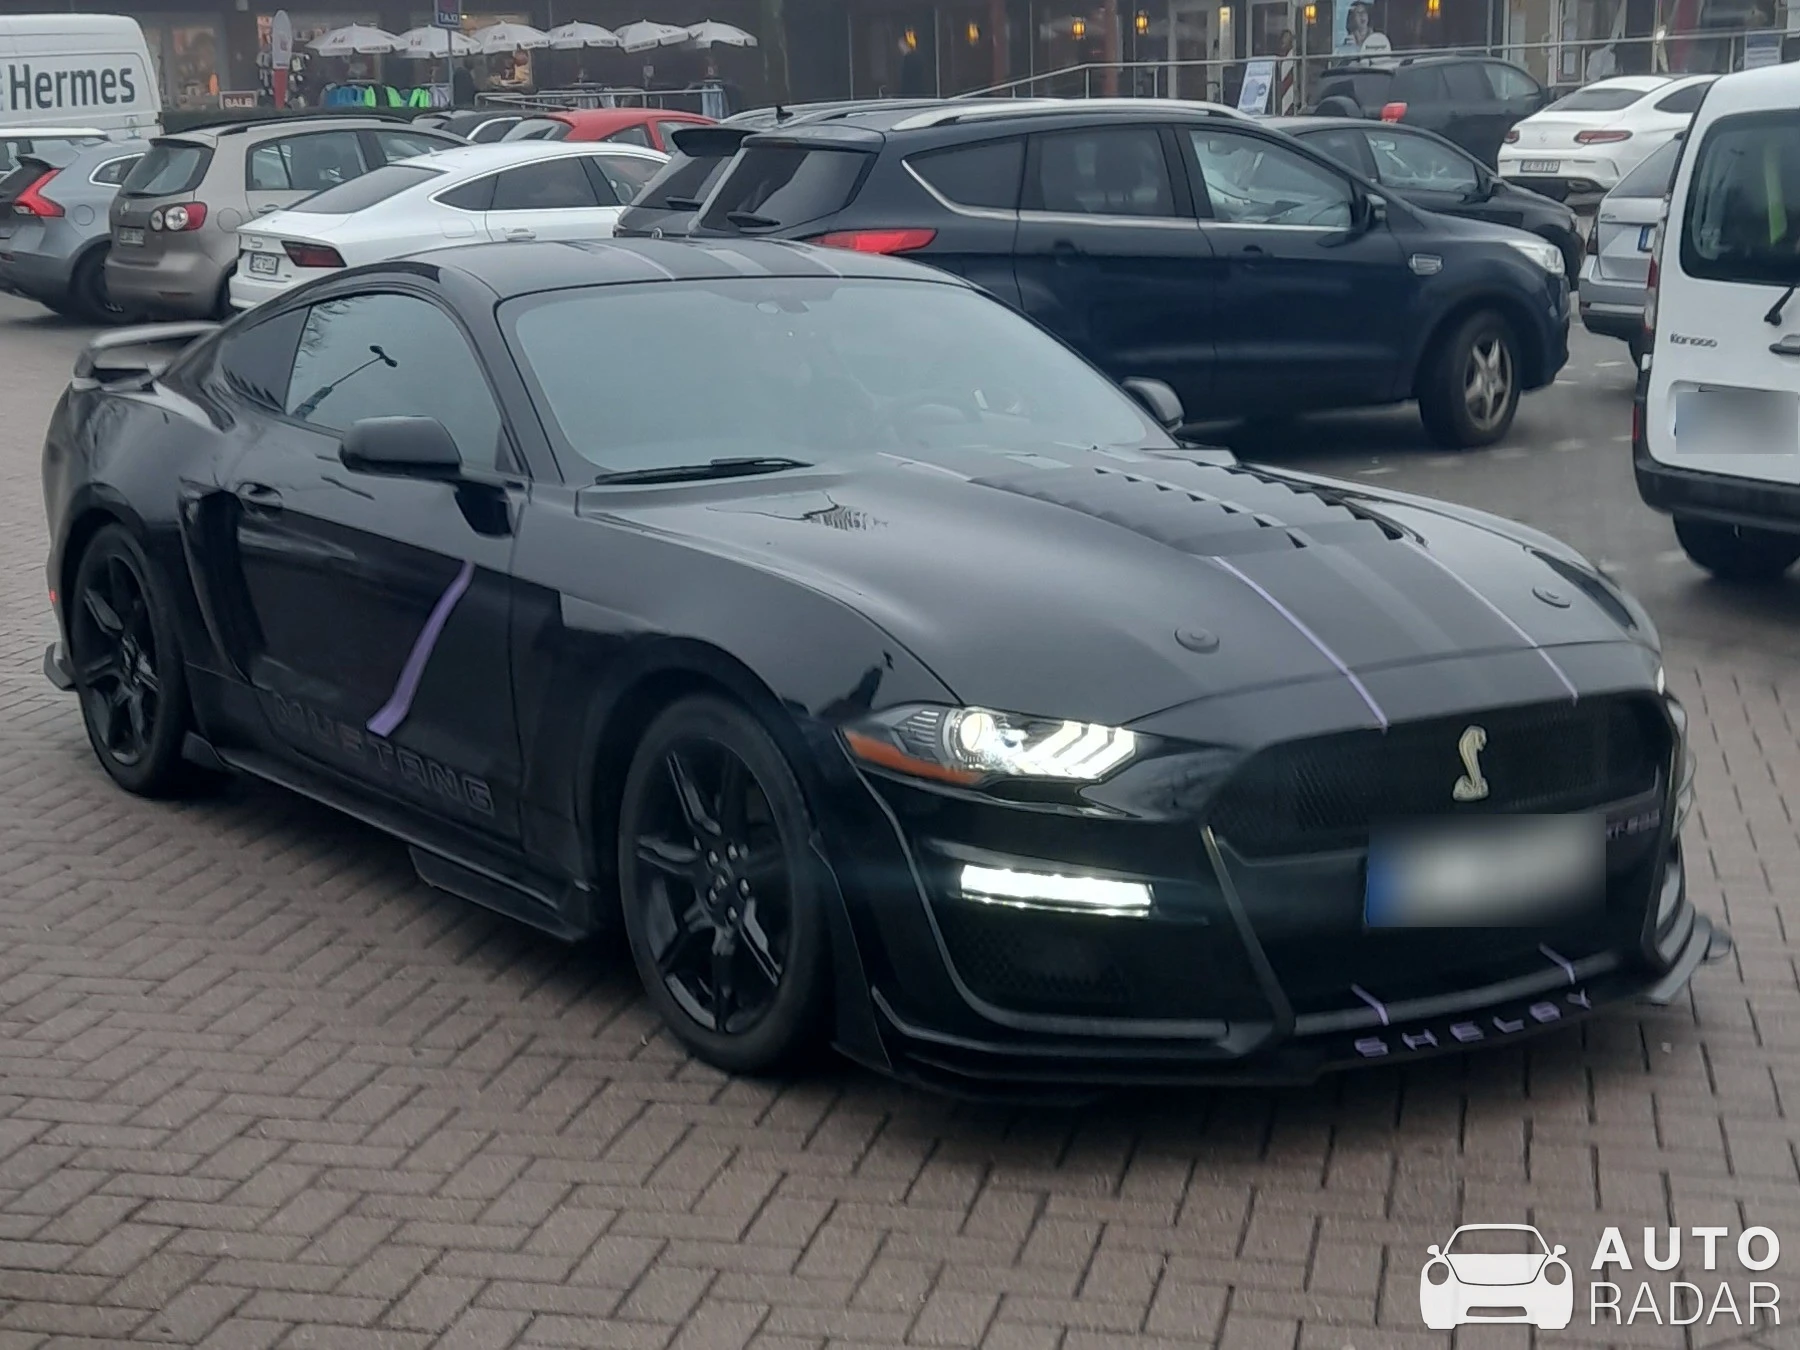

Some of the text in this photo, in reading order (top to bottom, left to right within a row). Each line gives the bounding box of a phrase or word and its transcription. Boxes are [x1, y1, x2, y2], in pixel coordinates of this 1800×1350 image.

[440, 12, 458, 23] TAXI
[8, 64, 136, 110] Hermes
[225, 98, 252, 108] SALE
[1354, 988, 1592, 1057] SHELBY
